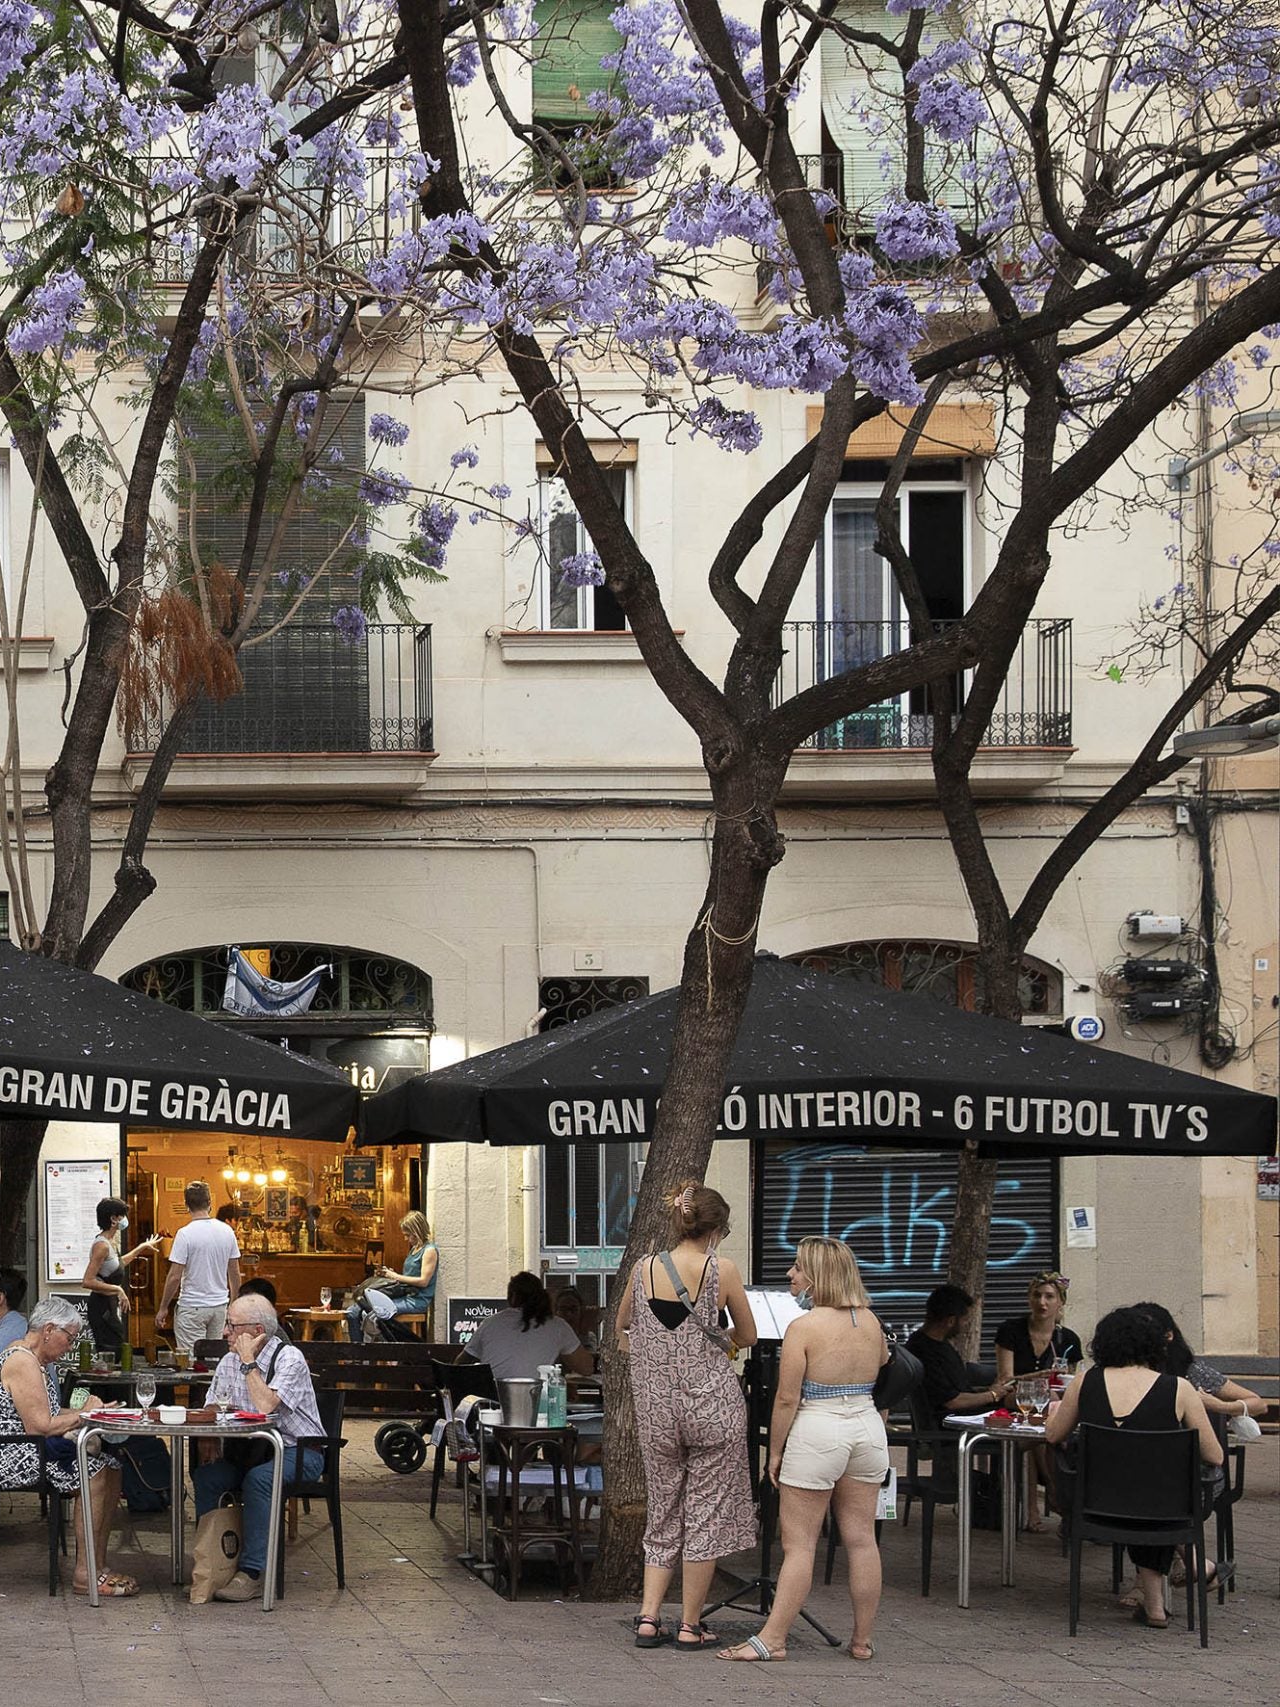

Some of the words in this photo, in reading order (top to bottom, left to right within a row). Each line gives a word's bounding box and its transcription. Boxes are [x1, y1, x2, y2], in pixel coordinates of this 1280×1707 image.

[104, 1077, 151, 1116] DE
[160, 1078, 291, 1130] GRÀCIA
[548, 1098, 646, 1137] GRAN
[758, 1089, 921, 1129] INTERIOR
[953, 1095, 974, 1130] 6
[985, 1096, 1120, 1137] FUTBOL
